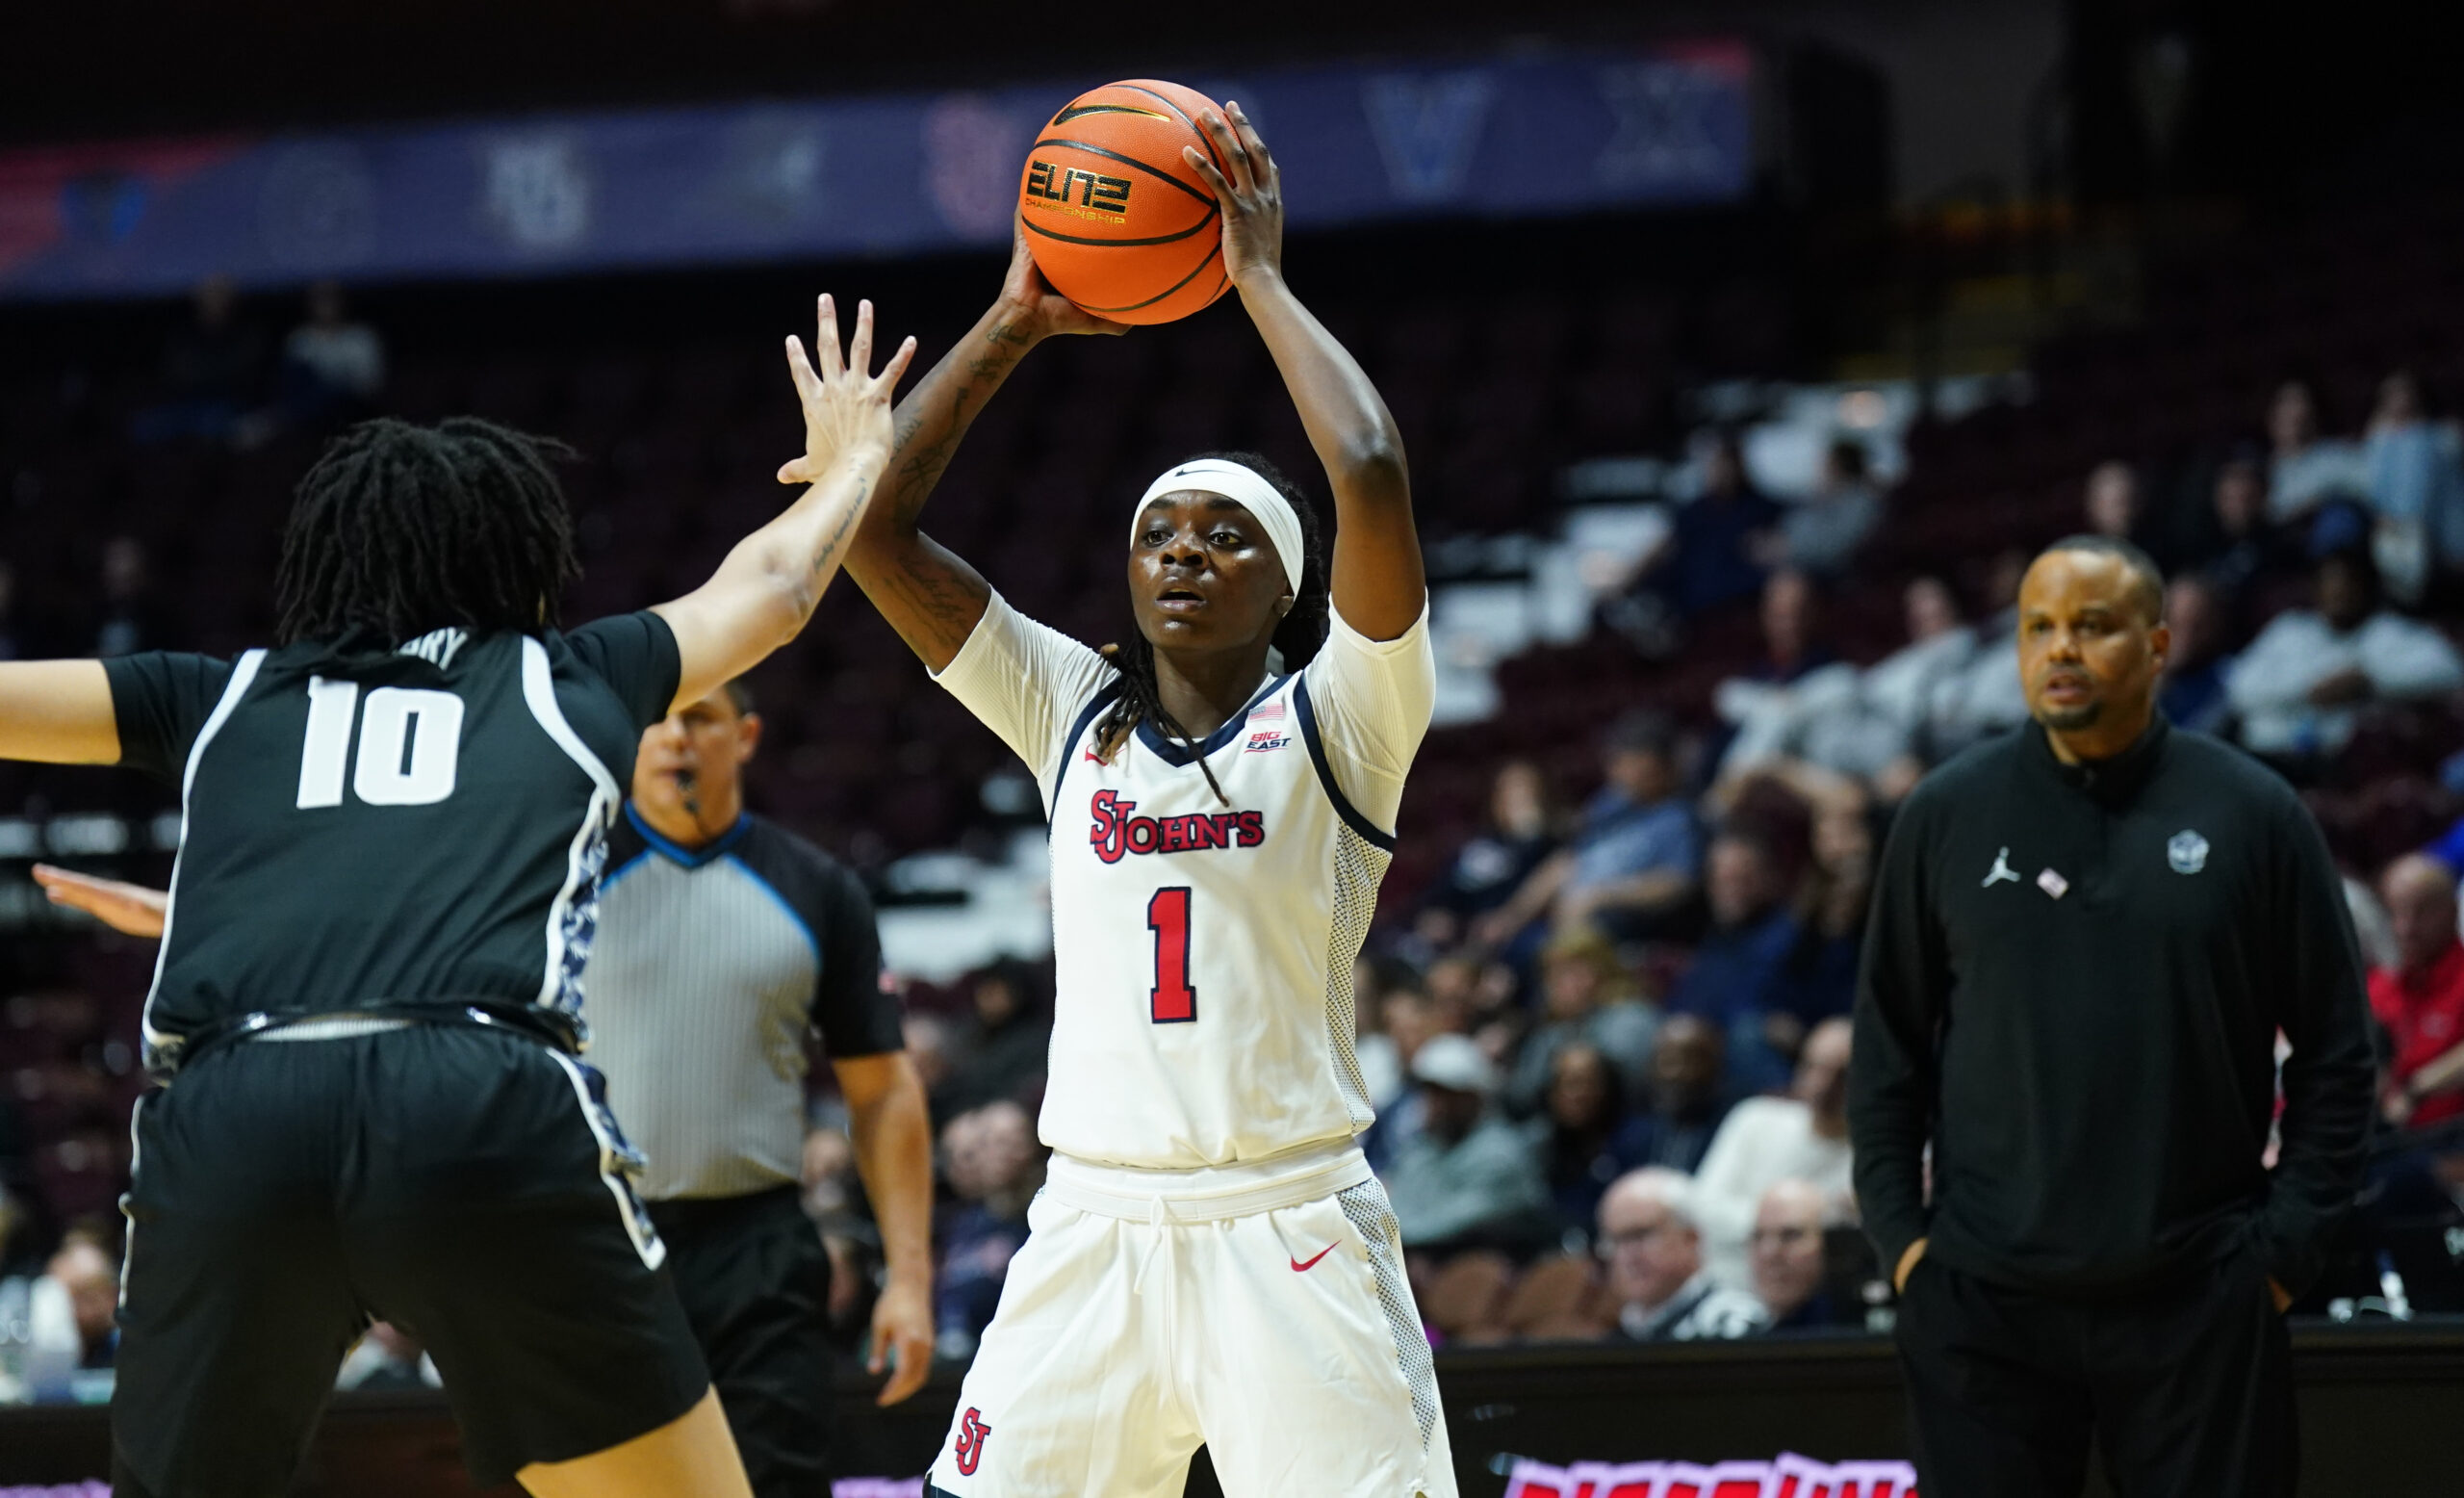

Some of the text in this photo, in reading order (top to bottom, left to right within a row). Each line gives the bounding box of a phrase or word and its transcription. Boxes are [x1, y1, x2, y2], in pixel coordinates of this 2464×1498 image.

[1027, 160, 1132, 215] ELITE
[1024, 197, 1127, 224] CHAMPIONSHIP
[296, 676, 465, 809] 10
[1247, 737, 1291, 749] EAST
[1251, 732, 1281, 741] BIG
[1147, 887, 1196, 1023] 1
